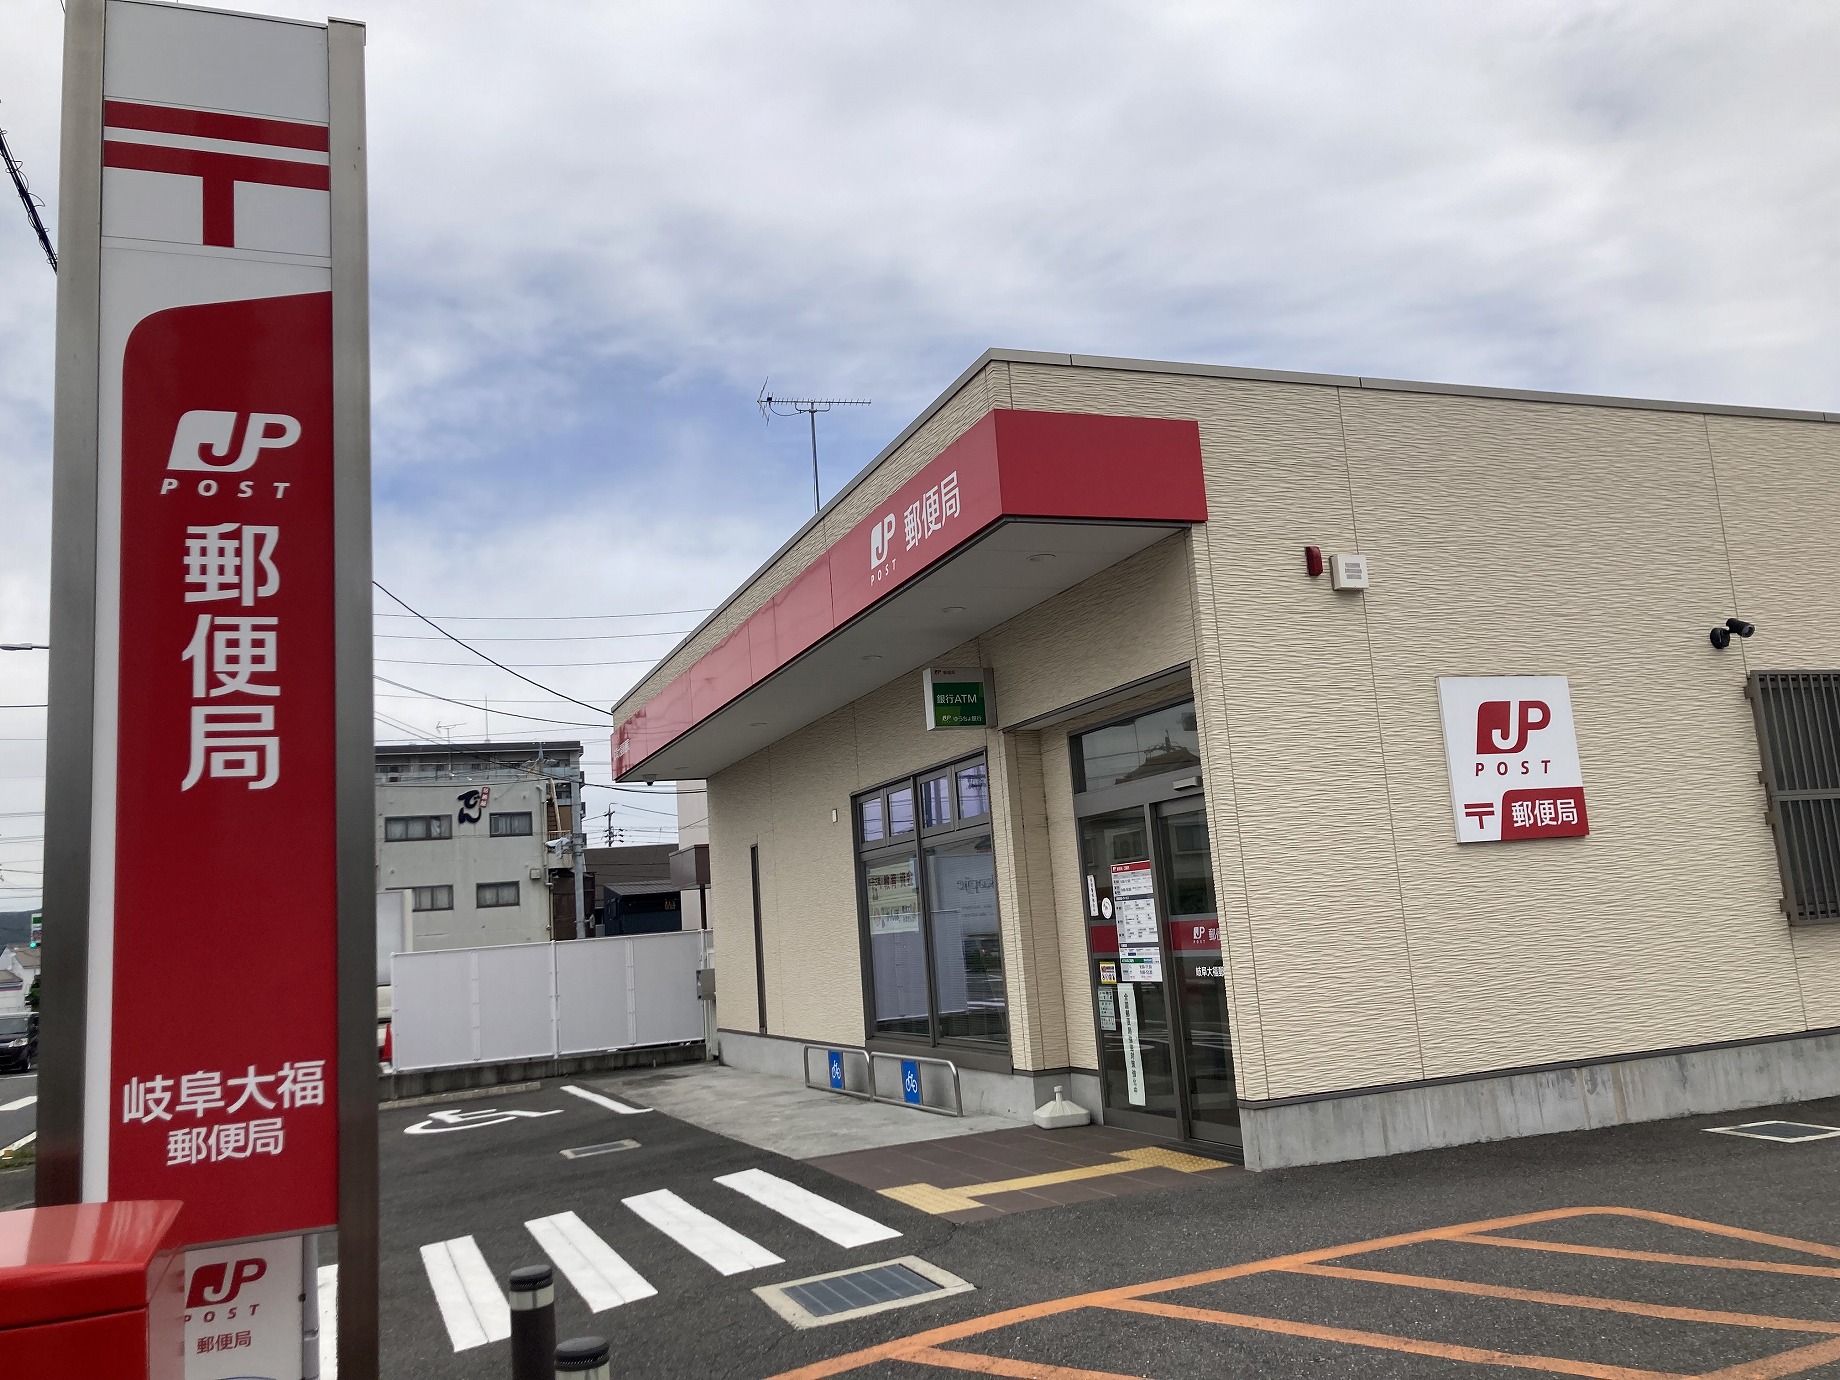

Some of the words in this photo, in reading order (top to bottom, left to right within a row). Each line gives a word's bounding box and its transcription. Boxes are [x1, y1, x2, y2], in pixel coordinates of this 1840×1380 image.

[167, 410, 302, 473] JP
[160, 478, 291, 500] POST
[904, 470, 960, 552] 郵便局
[870, 512, 896, 570] JP
[870, 558, 896, 587] POST
[181, 523, 282, 793] 郵便局
[936, 694, 977, 704] 銀行ATM
[1476, 700, 1552, 755] JP
[1475, 760, 1551, 777] POST
[1511, 798, 1578, 828] 郵便局
[122, 1060, 325, 1125] 岐阜大福
[166, 1117, 285, 1167] 郵便局
[196, 1330, 252, 1355] 郵便局
